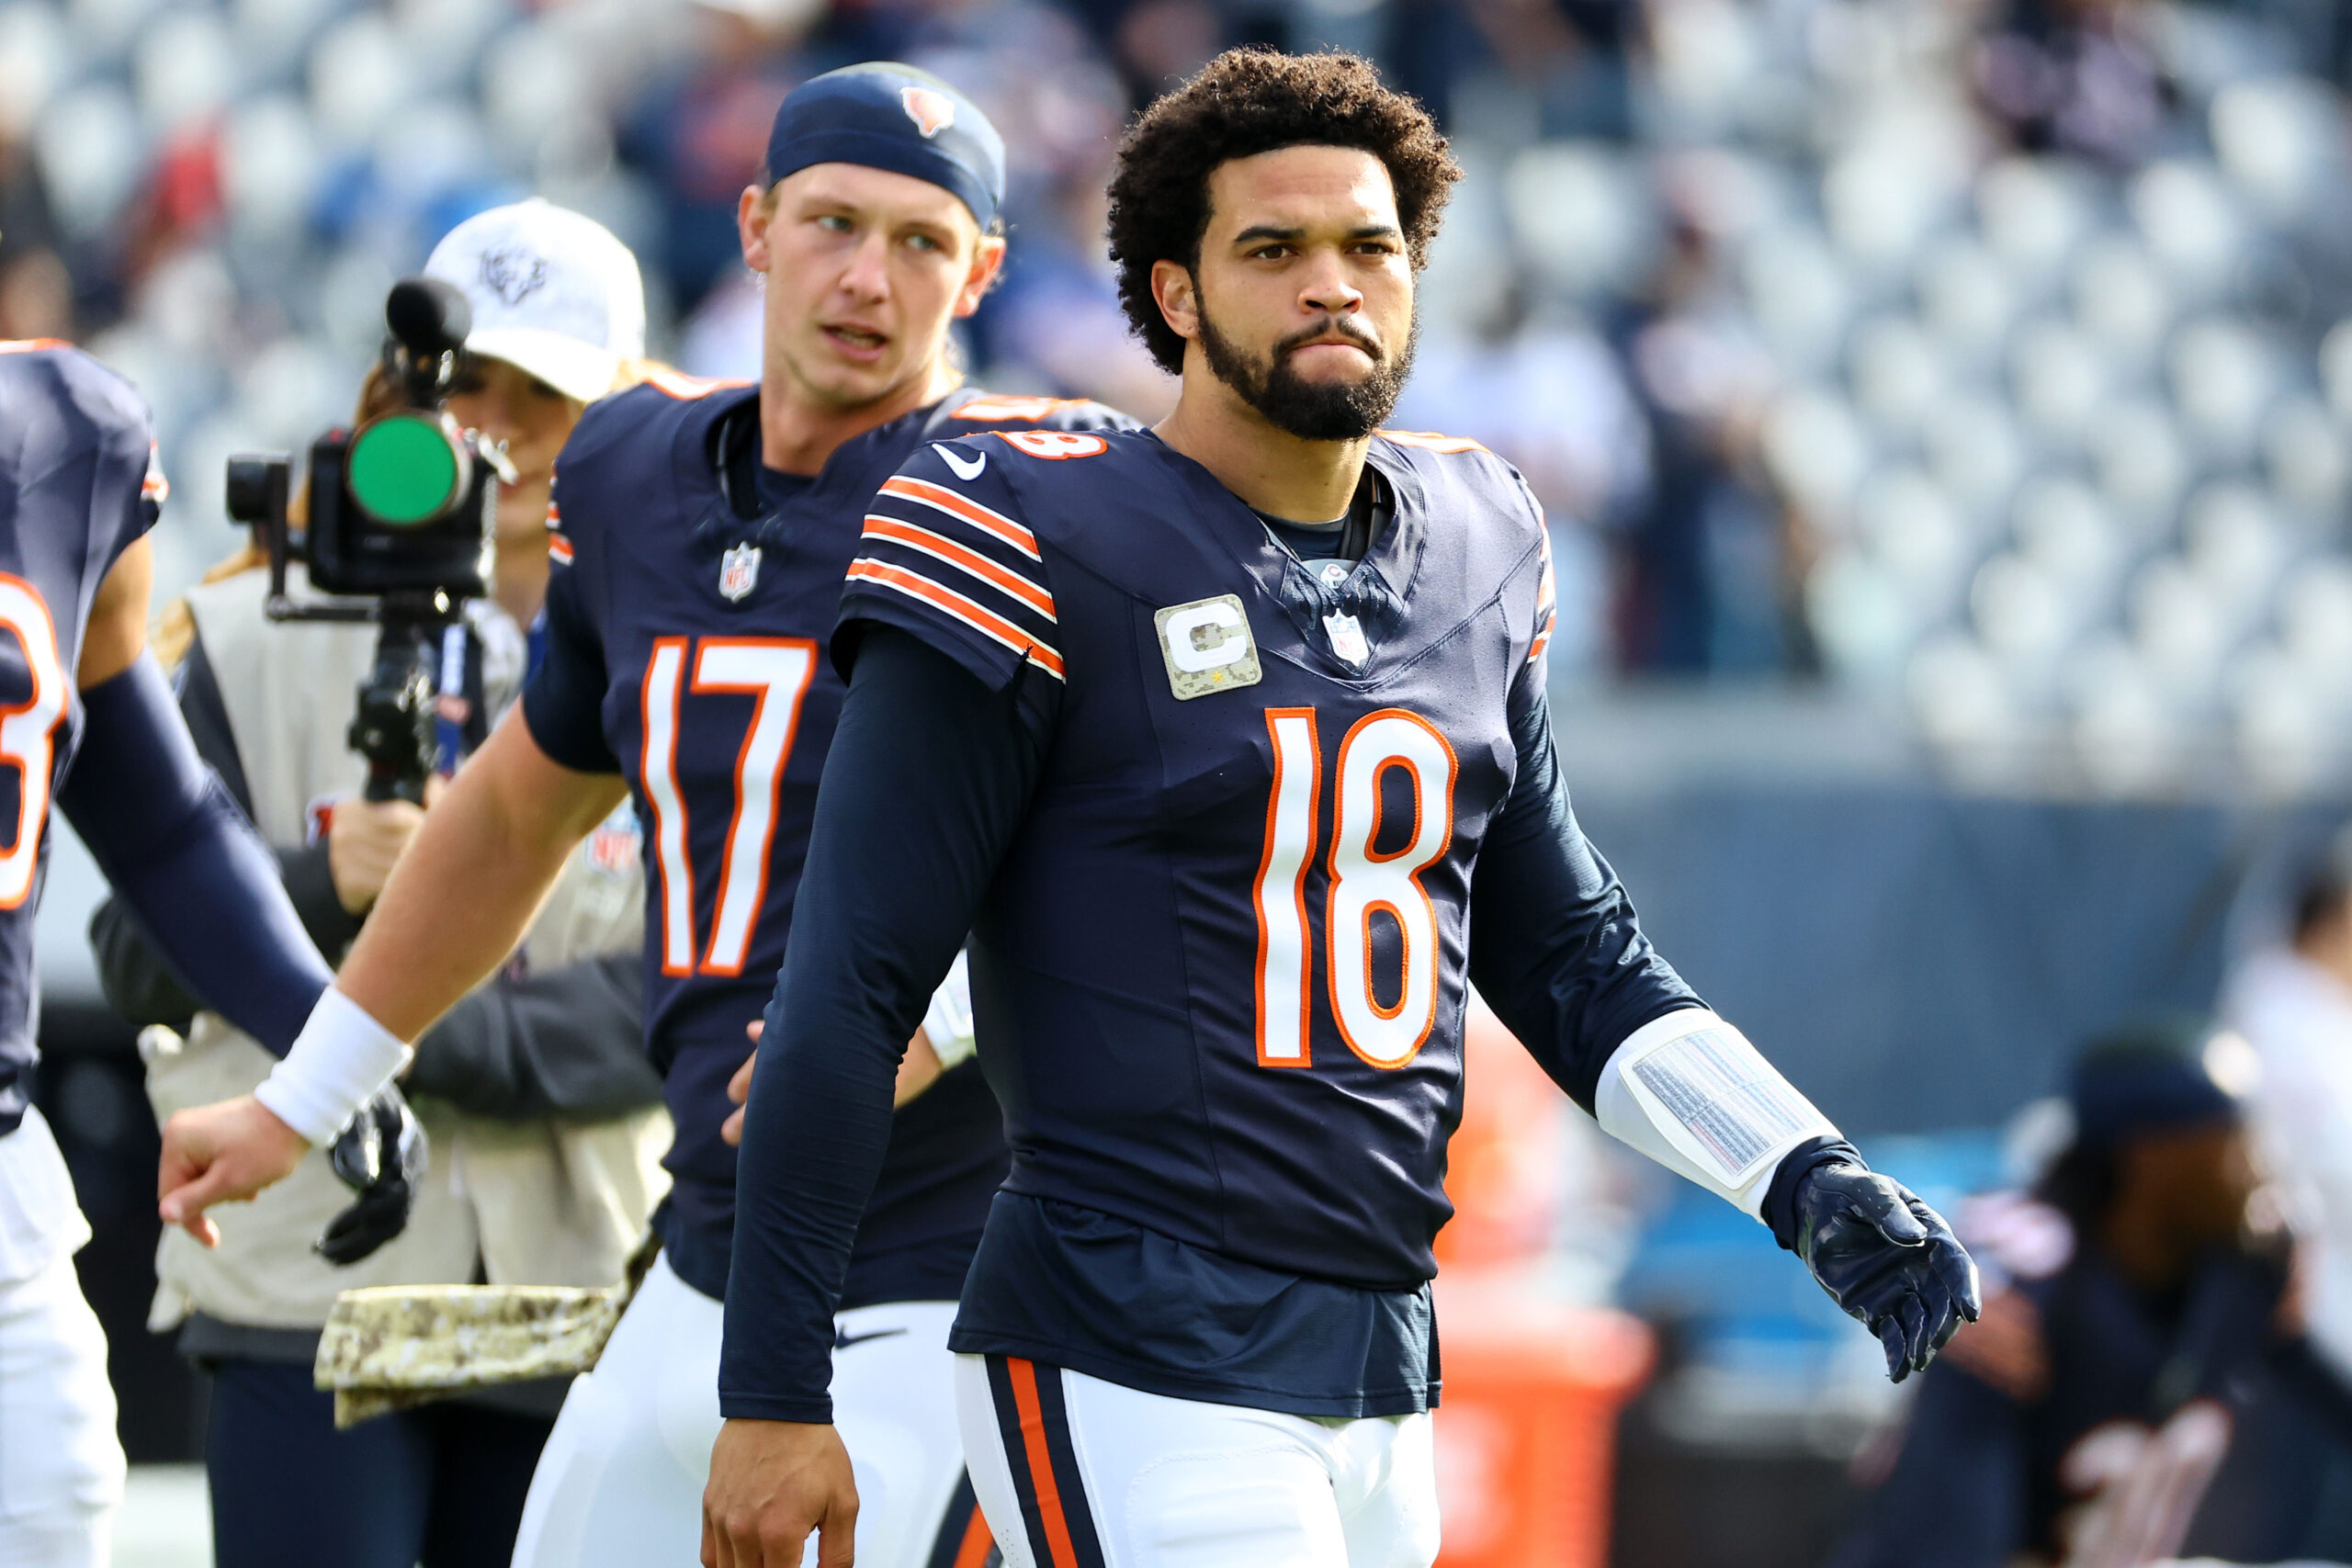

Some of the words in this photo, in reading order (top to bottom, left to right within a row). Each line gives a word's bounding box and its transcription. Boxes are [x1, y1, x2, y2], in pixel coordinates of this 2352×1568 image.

[639, 635, 819, 977] 17
[1165, 602, 1248, 672] C
[1252, 706, 1459, 1070] 18
